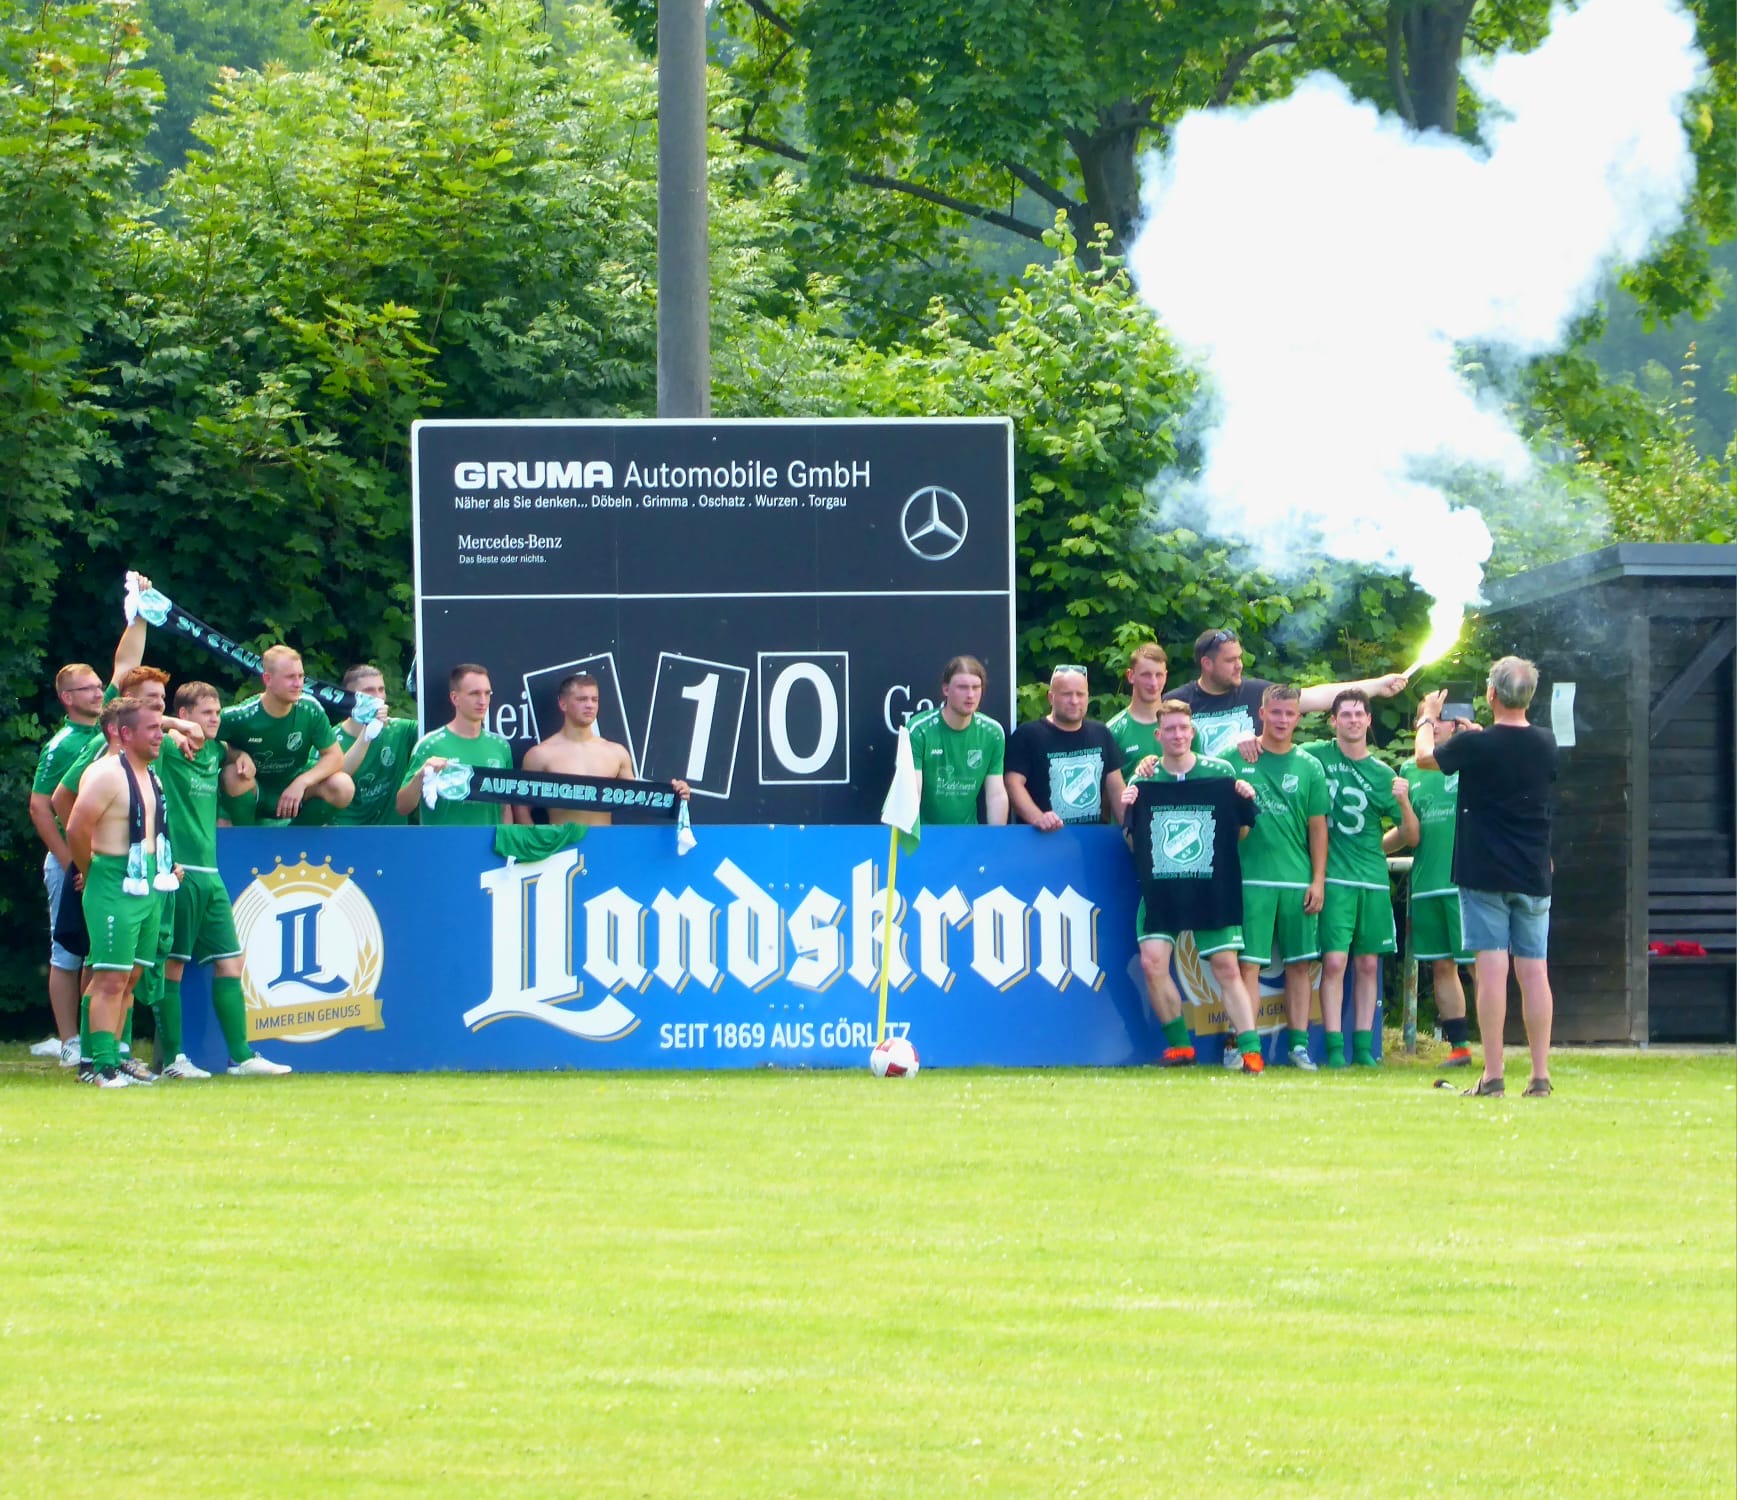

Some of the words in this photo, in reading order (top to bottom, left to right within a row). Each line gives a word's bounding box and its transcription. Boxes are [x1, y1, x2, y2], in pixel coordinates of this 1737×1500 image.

[454, 461, 613, 490] GRUMA
[624, 460, 778, 488] Automobile
[788, 460, 871, 488] GmbH
[455, 496, 490, 509] Näher
[493, 496, 510, 509] als
[514, 496, 532, 508] Sie
[535, 496, 588, 508] denken...
[592, 494, 632, 508] Döbeln
[642, 494, 688, 508] Grimma
[699, 494, 745, 508] Oschatz
[755, 494, 798, 508] Wurzen
[809, 494, 847, 510] Torgau
[458, 534, 562, 550] Mercedes-Benz
[459, 555, 474, 564] Das
[476, 555, 499, 564] Beste
[500, 555, 518, 564] oder
[520, 554, 547, 563] nichts.
[176, 616, 203, 638] SV
[480, 776, 597, 801] AUFSTEIGER
[602, 788, 675, 808] 2024/25
[463, 848, 1104, 1040] Landskron
[255, 1013, 294, 1031] IMMER
[297, 1009, 315, 1025] EIN
[317, 1004, 361, 1022] GENUSS
[660, 1023, 709, 1048] SEIT
[713, 1023, 765, 1048] 1869
[771, 1023, 814, 1048] AUS
